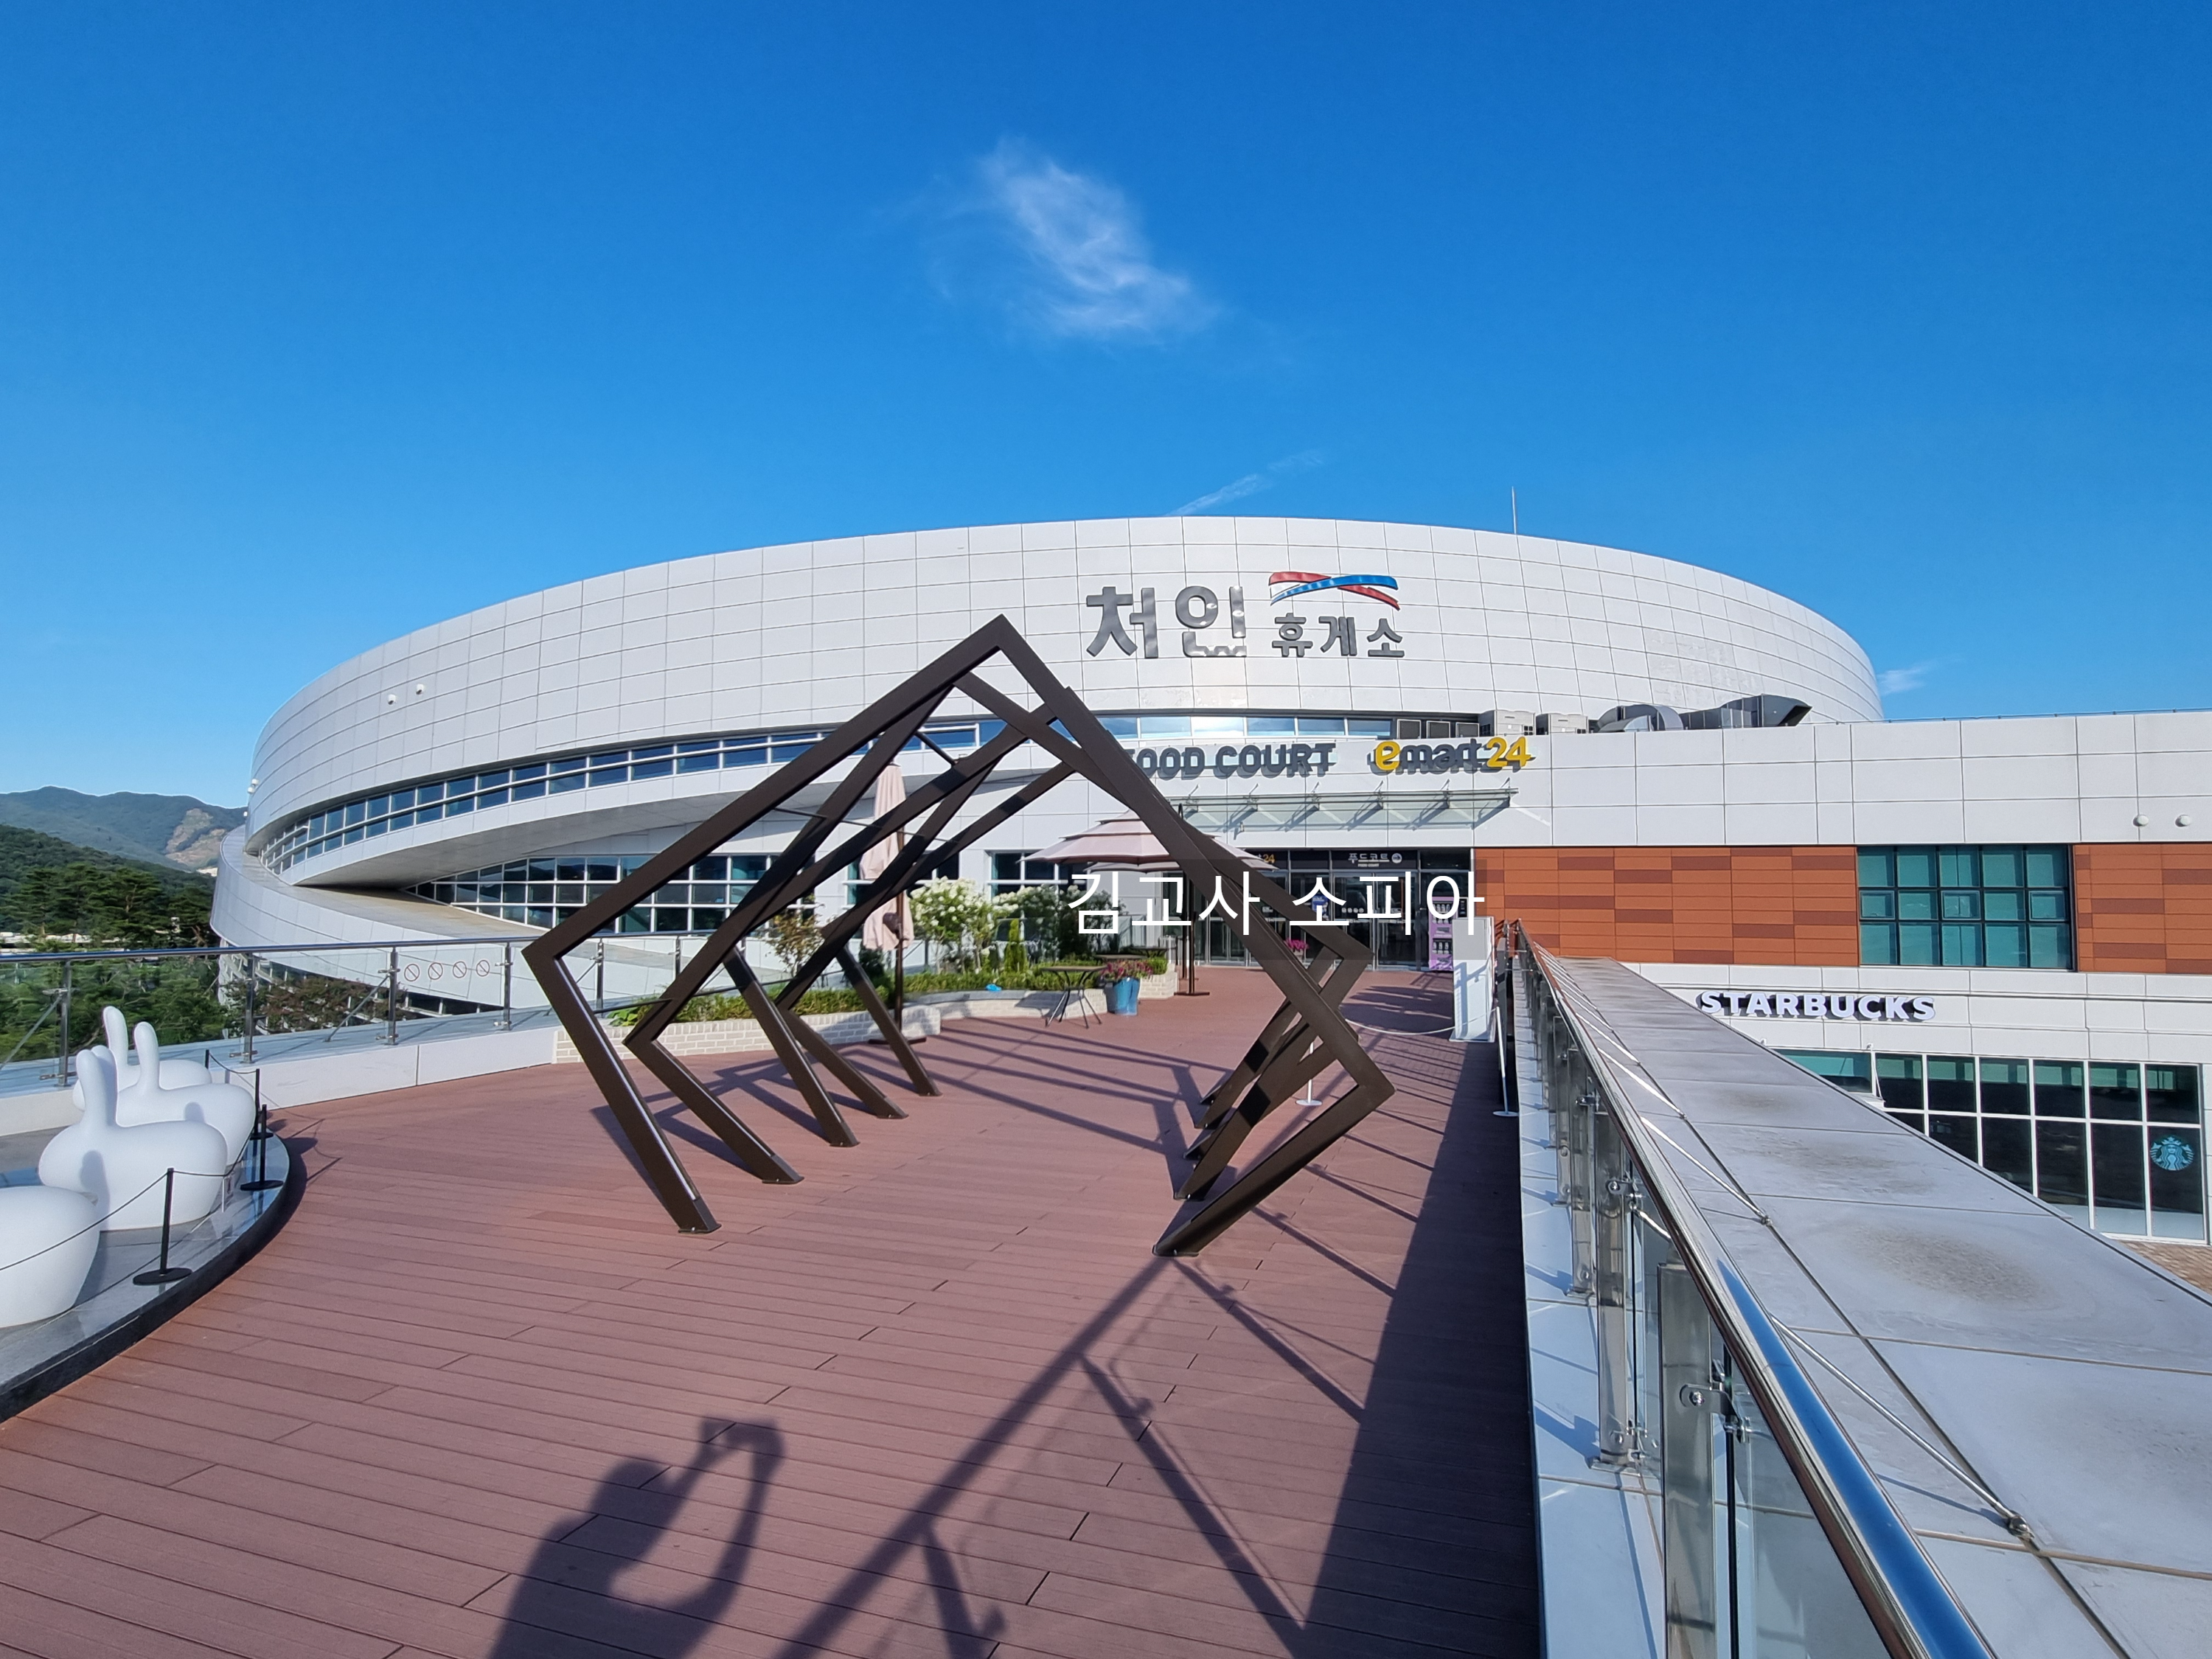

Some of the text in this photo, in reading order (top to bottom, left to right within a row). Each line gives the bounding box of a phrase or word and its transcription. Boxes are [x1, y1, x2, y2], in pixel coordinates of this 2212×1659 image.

[1086, 585, 1405, 658] 처인 휴게소
[1215, 742, 1336, 779] COURT
[1374, 737, 1531, 773] emart24
[1348, 852, 1390, 863] 푸드코트
[1697, 991, 1935, 1020] STARBUCKS
